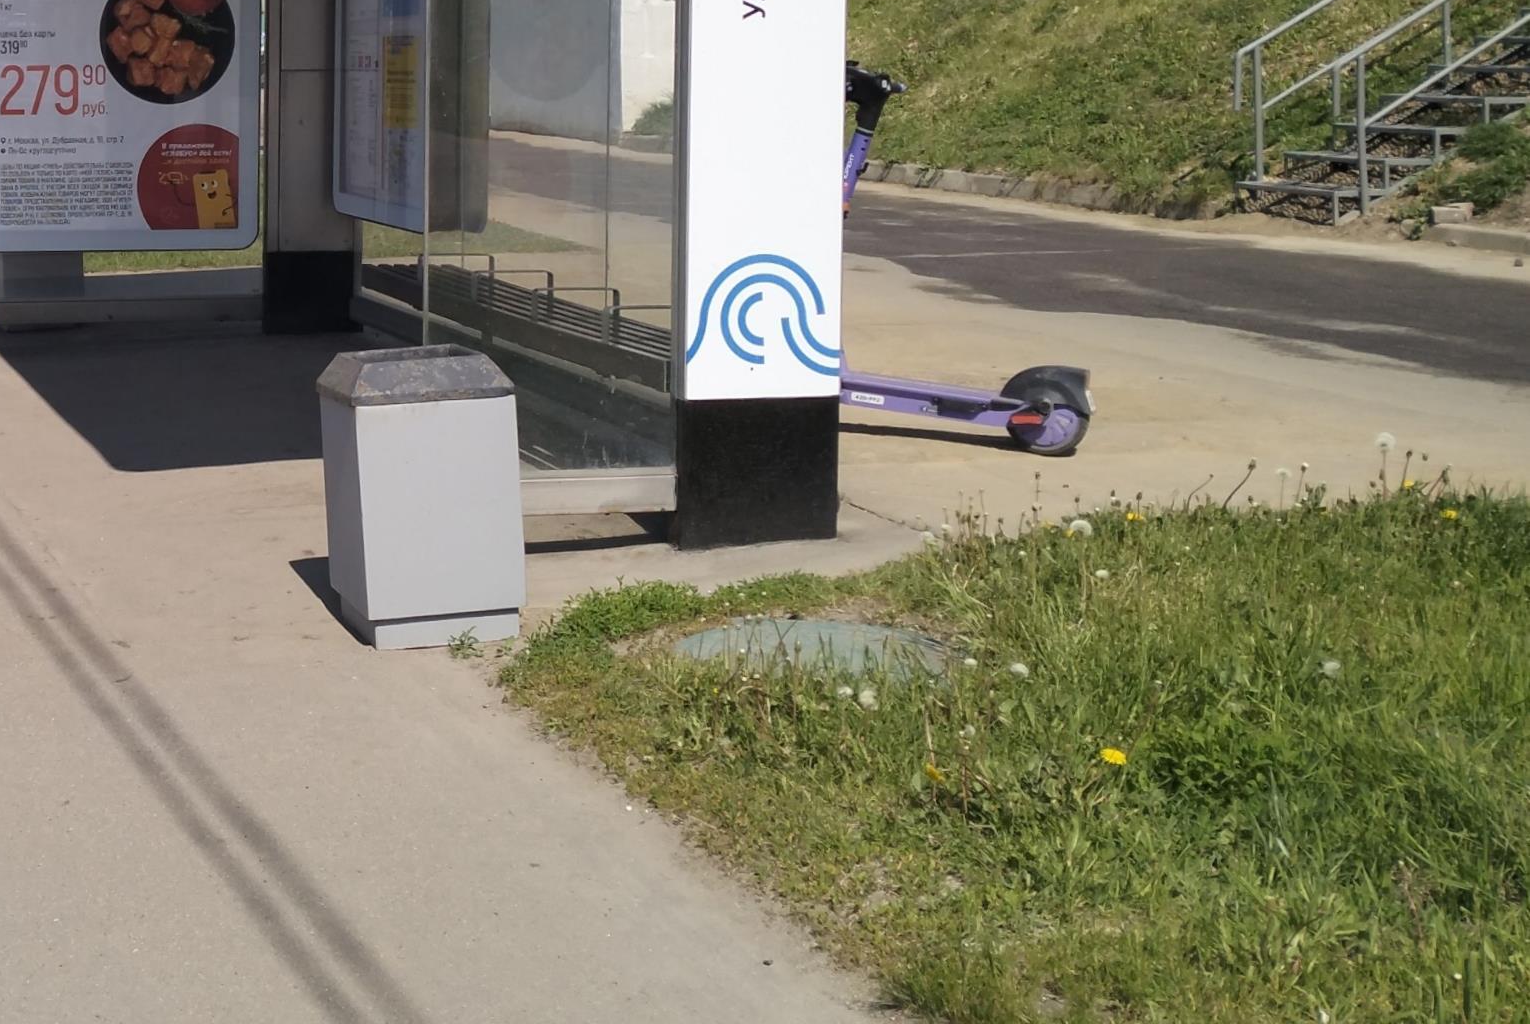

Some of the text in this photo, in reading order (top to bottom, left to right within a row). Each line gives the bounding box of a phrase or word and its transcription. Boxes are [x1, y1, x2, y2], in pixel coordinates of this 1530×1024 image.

[0, 64, 106, 116] 279 90
[82, 100, 108, 117] руб.
